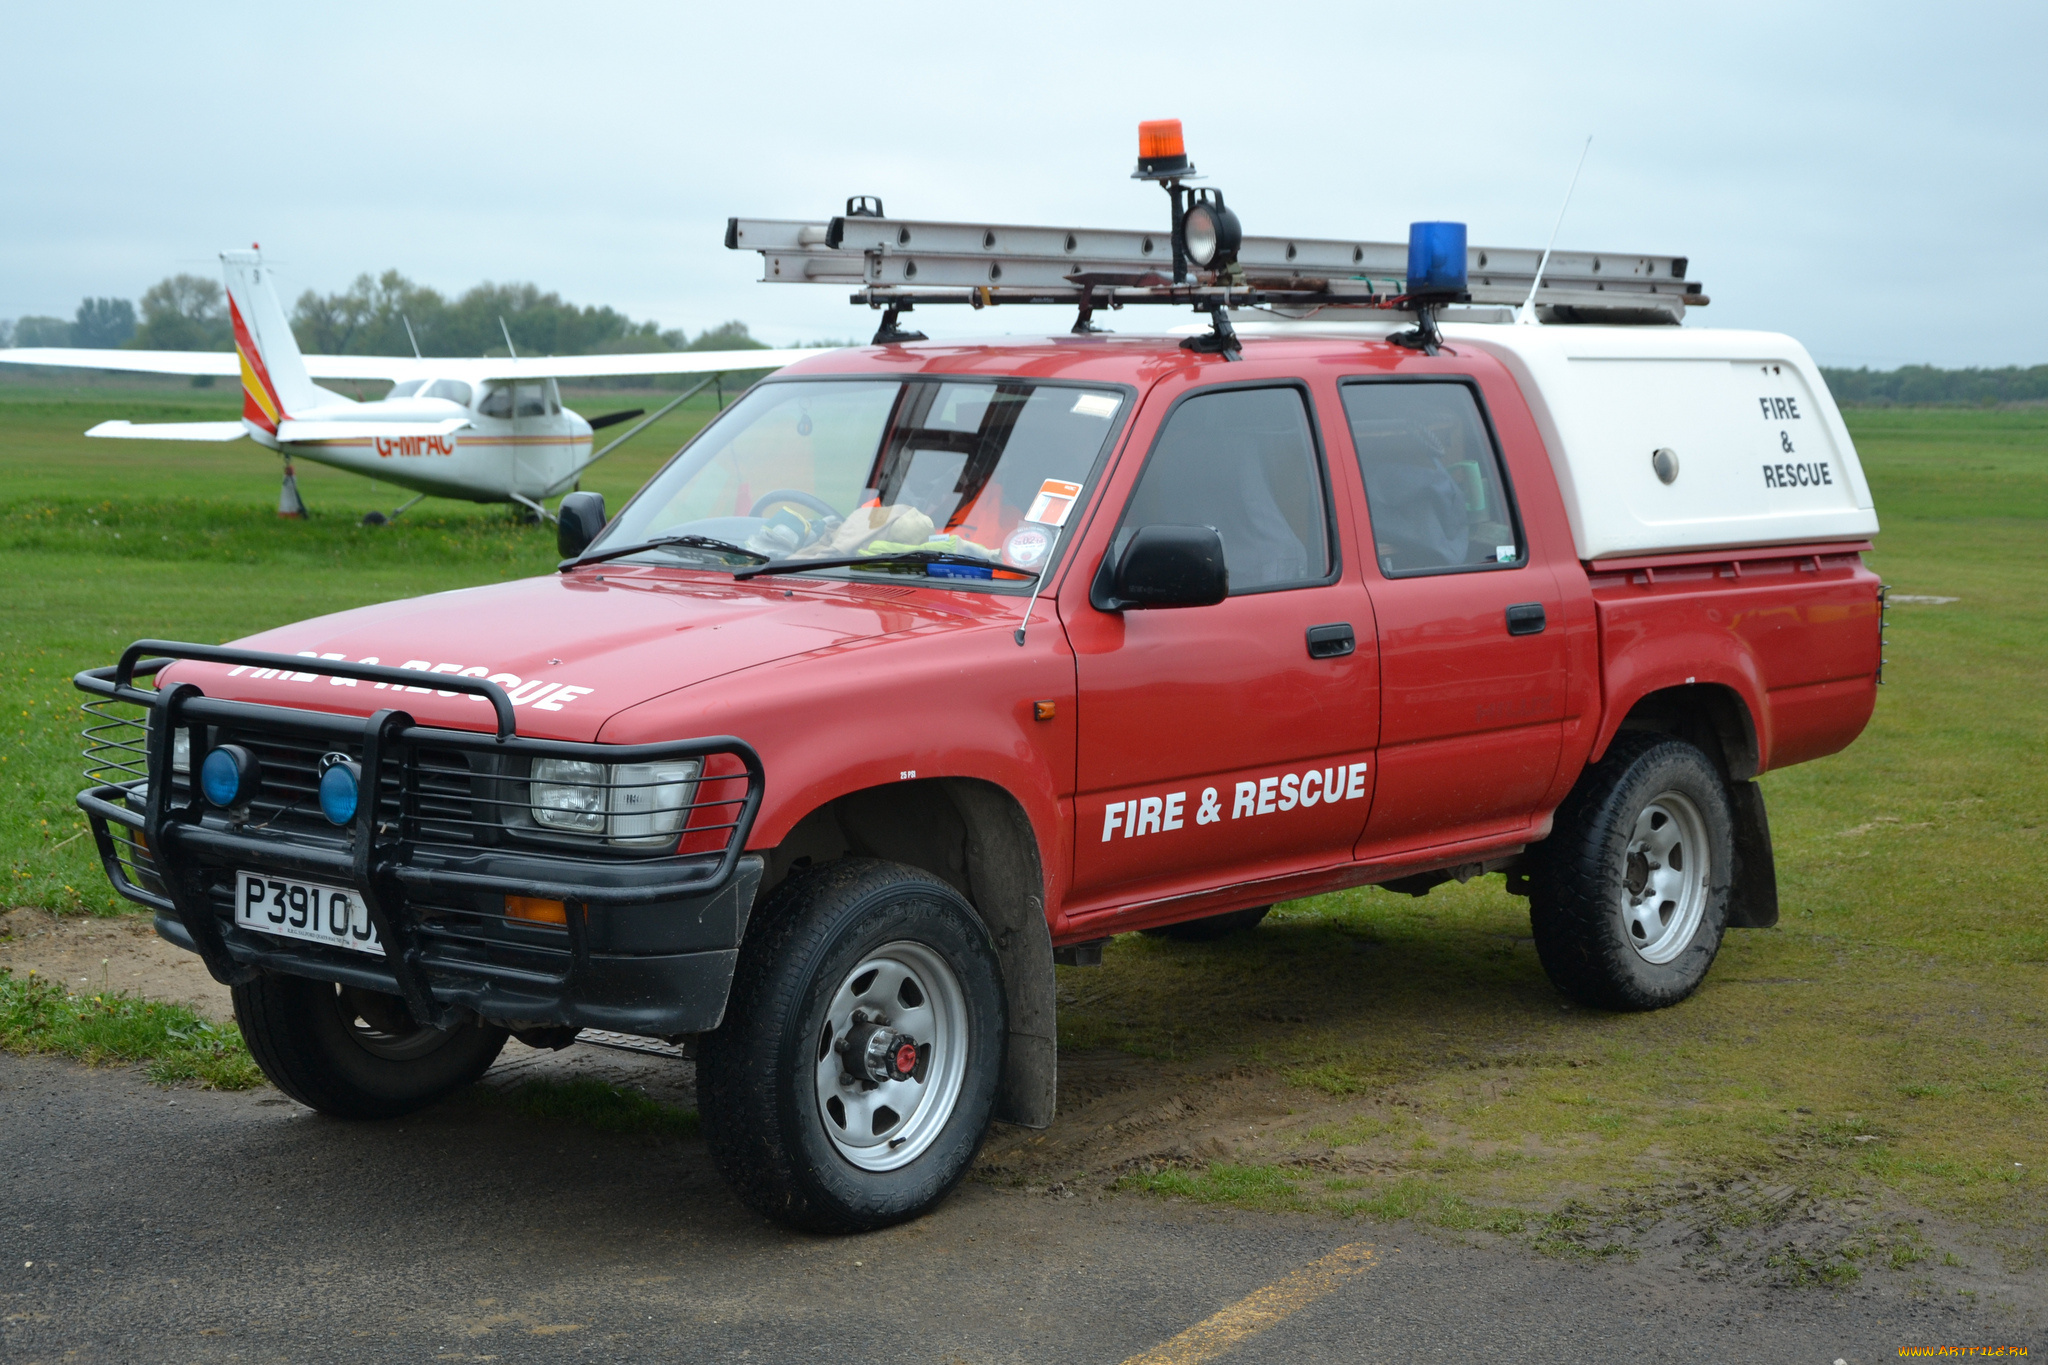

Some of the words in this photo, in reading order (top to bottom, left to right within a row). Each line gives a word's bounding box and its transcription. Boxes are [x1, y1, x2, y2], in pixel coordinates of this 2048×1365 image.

[1759, 397, 1801, 420] FIRE
[1780, 430, 1795, 453] &
[1762, 462, 1832, 489] RESCUE
[1101, 790, 1186, 842] FIRE
[1196, 787, 1222, 825] &
[1231, 762, 1368, 820] RESCUE
[245, 877, 320, 931] P391
[329, 892, 382, 945] OJ
